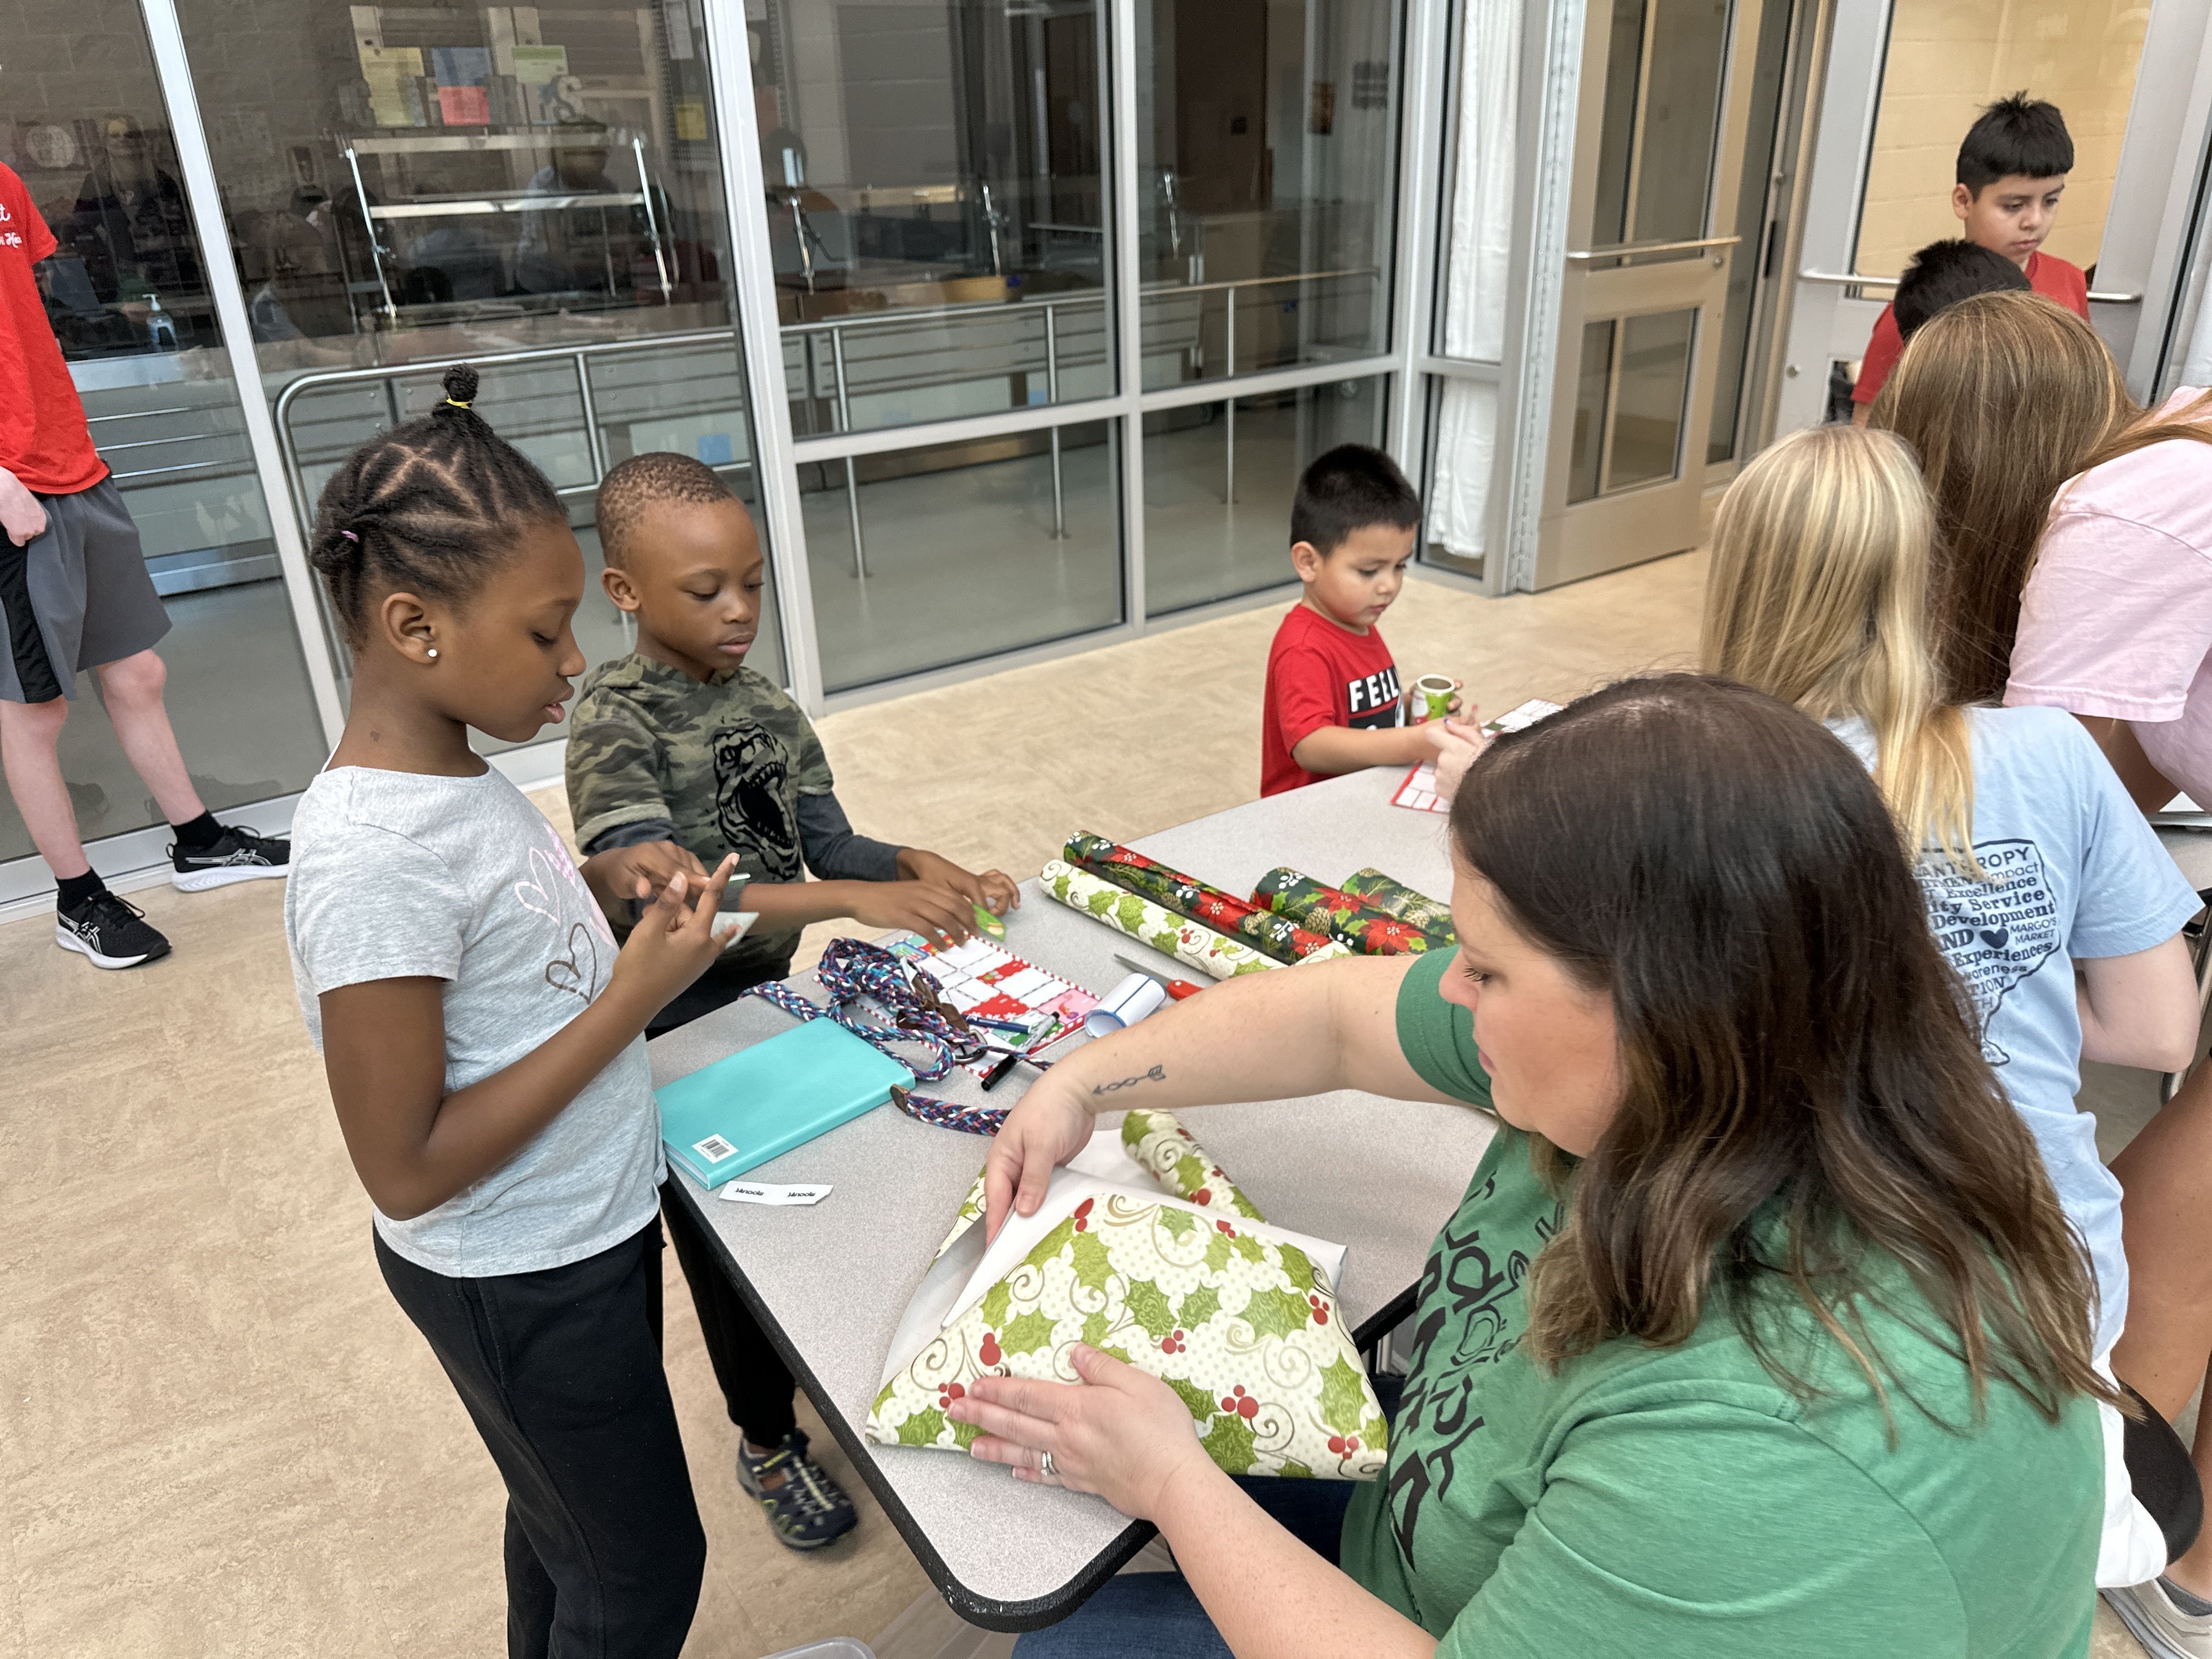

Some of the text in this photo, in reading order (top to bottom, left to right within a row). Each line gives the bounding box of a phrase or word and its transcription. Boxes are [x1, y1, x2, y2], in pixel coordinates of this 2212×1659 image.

[1948, 876, 2038, 899] Excellence
[1968, 889, 2045, 911] Service
[1931, 900, 2055, 930] Development
[2010, 917, 2057, 934] MARGO'S
[2015, 929, 2055, 945] MARKET
[1952, 942, 2053, 968] Experiences
